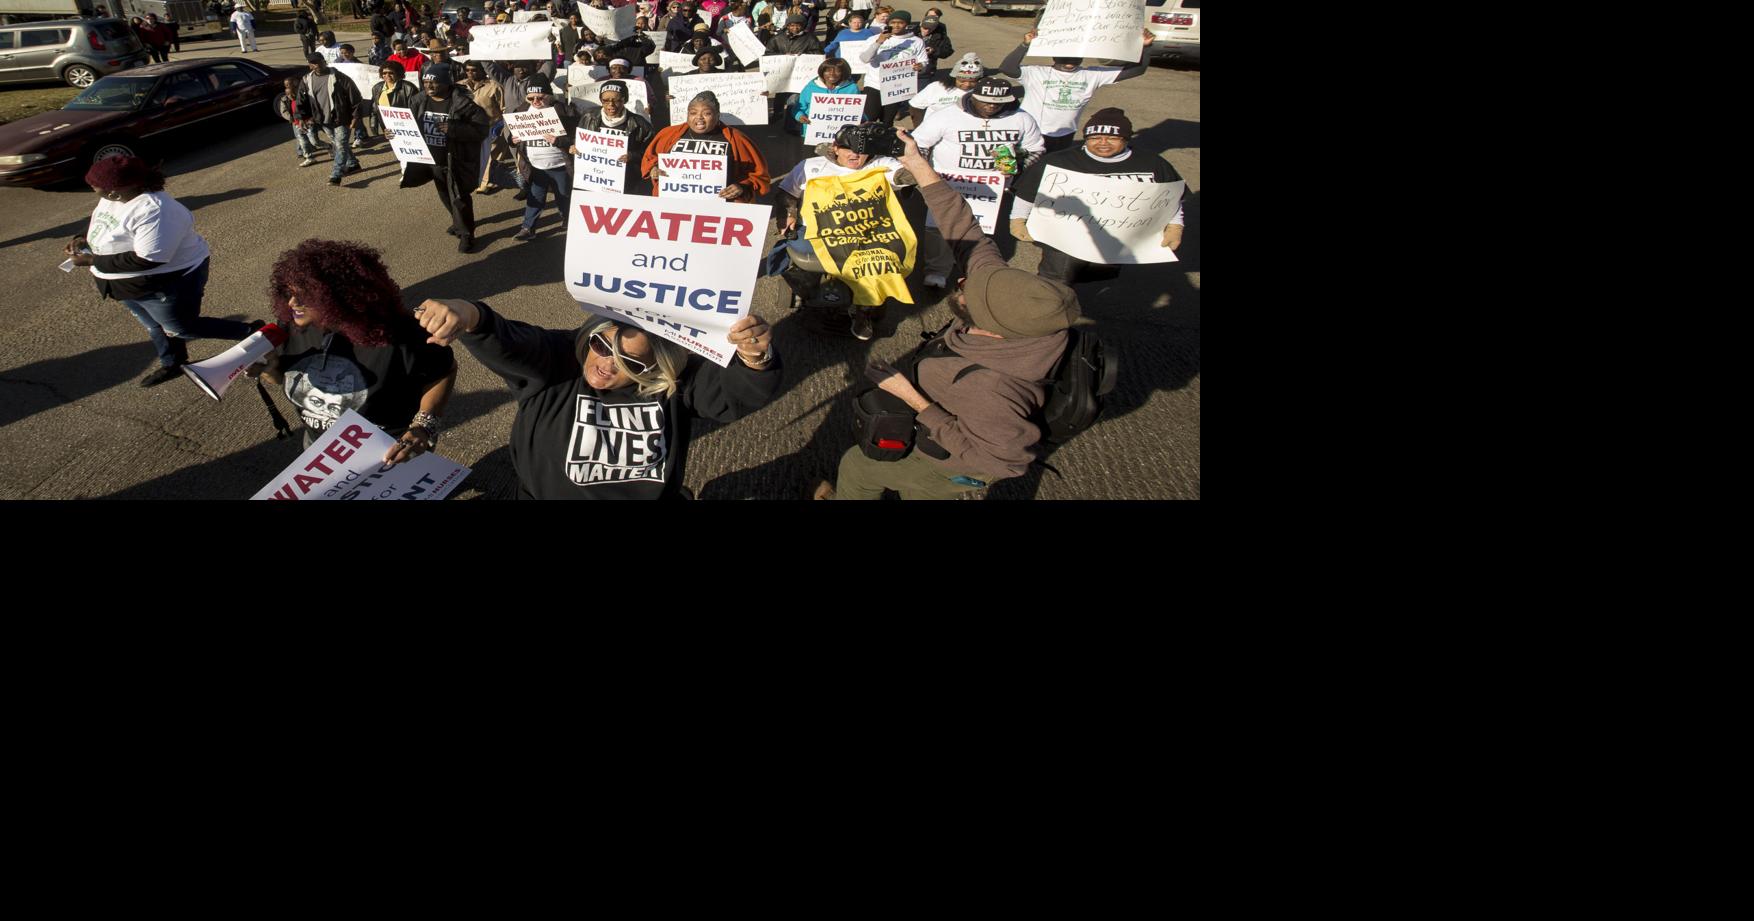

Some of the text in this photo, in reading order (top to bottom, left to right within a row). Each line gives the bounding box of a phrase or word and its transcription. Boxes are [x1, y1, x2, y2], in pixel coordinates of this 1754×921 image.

[882, 59, 917, 69] WATER
[881, 72, 916, 83] JUSTICE
[888, 88, 910, 97] FLINT
[981, 86, 1009, 96] FLINT
[813, 96, 862, 105] WATER
[381, 109, 413, 121] WATER
[514, 112, 543, 121] Polluted
[811, 113, 859, 122] JUSTICE
[508, 118, 559, 131] Drinking Water
[1085, 125, 1120, 136] FLINT
[525, 128, 555, 137] Violence
[960, 131, 1019, 142] FLINT
[579, 131, 625, 148] WATER
[400, 147, 423, 156] FLINT
[961, 144, 996, 157] LIV
[577, 152, 623, 167] JUSTICE
[662, 158, 723, 170] WATER
[961, 158, 995, 170] MAT
[583, 174, 615, 187] FLINT
[682, 172, 702, 180] and
[662, 182, 722, 194] JUSTICE
[1045, 171, 1150, 212] Resist
[831, 207, 874, 225] Poor
[1037, 199, 1152, 230] Corruption
[579, 205, 754, 247] WATER
[632, 253, 689, 272] and
[573, 272, 742, 314] JUSTICE
[605, 305, 707, 338] FLINT
[678, 335, 724, 359] NURSES
[579, 399, 660, 431] FLINT
[571, 427, 664, 466] LIVES
[268, 424, 373, 500] WATER
[570, 463, 658, 483] MATTER
[322, 469, 361, 498] and
